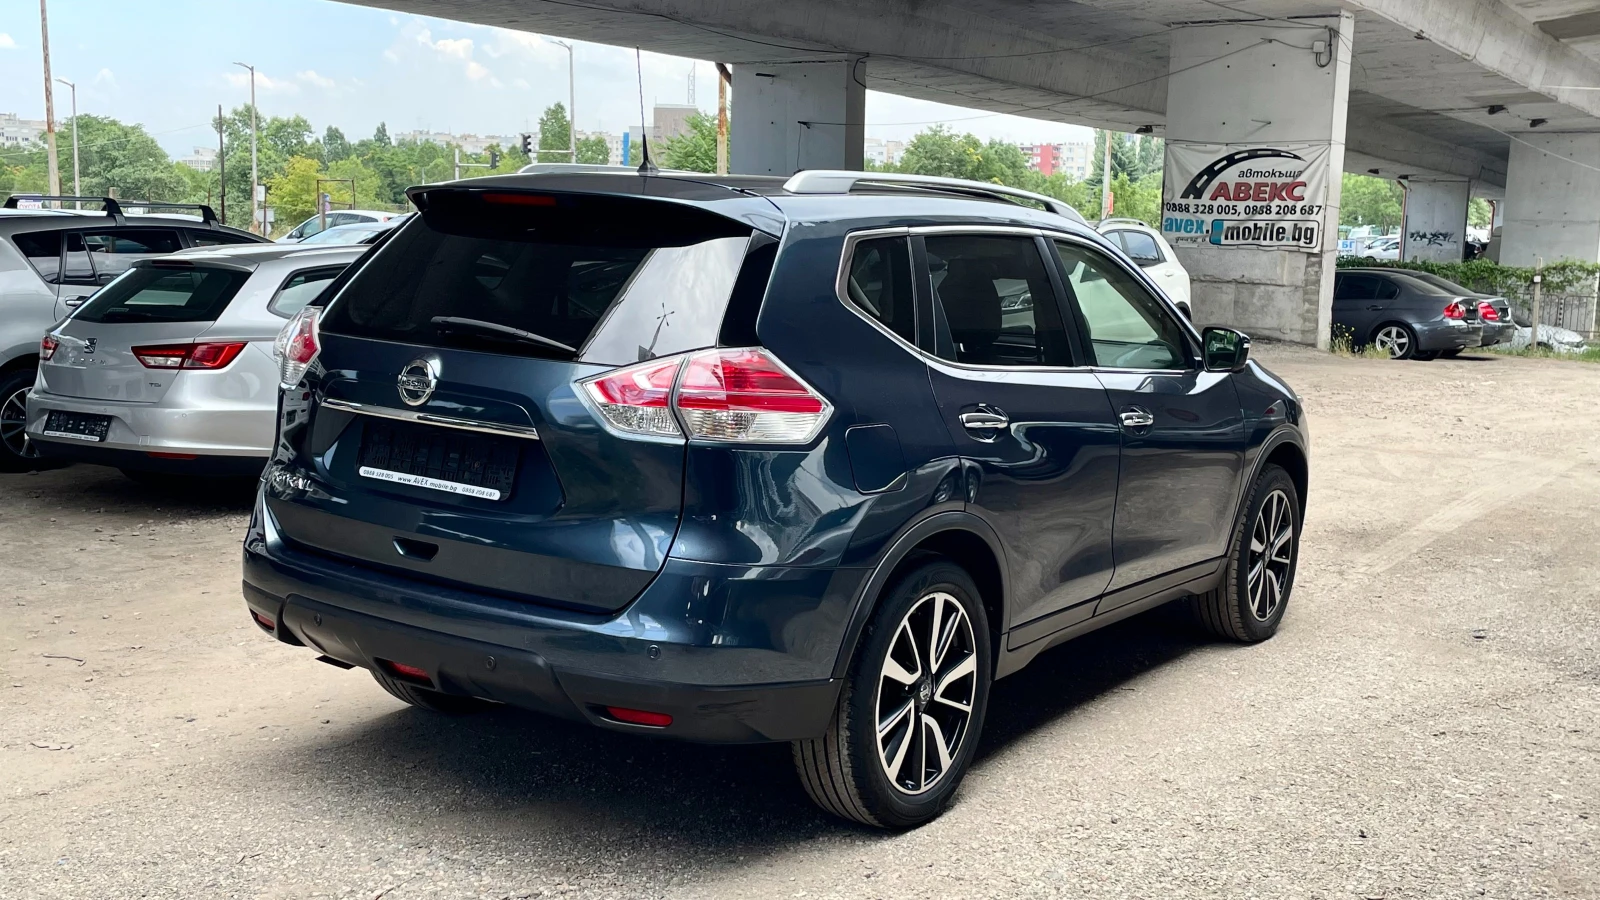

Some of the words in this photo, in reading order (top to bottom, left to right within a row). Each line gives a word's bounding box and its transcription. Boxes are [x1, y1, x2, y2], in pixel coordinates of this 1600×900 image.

[1209, 181, 1307, 202] АВЕКС
[1165, 202, 1190, 213] 0888
[1193, 204, 1214, 215] 328
[1216, 205, 1241, 217] 005,
[1244, 205, 1272, 216] 0888
[1275, 205, 1297, 216] 208
[1300, 205, 1322, 216] 687
